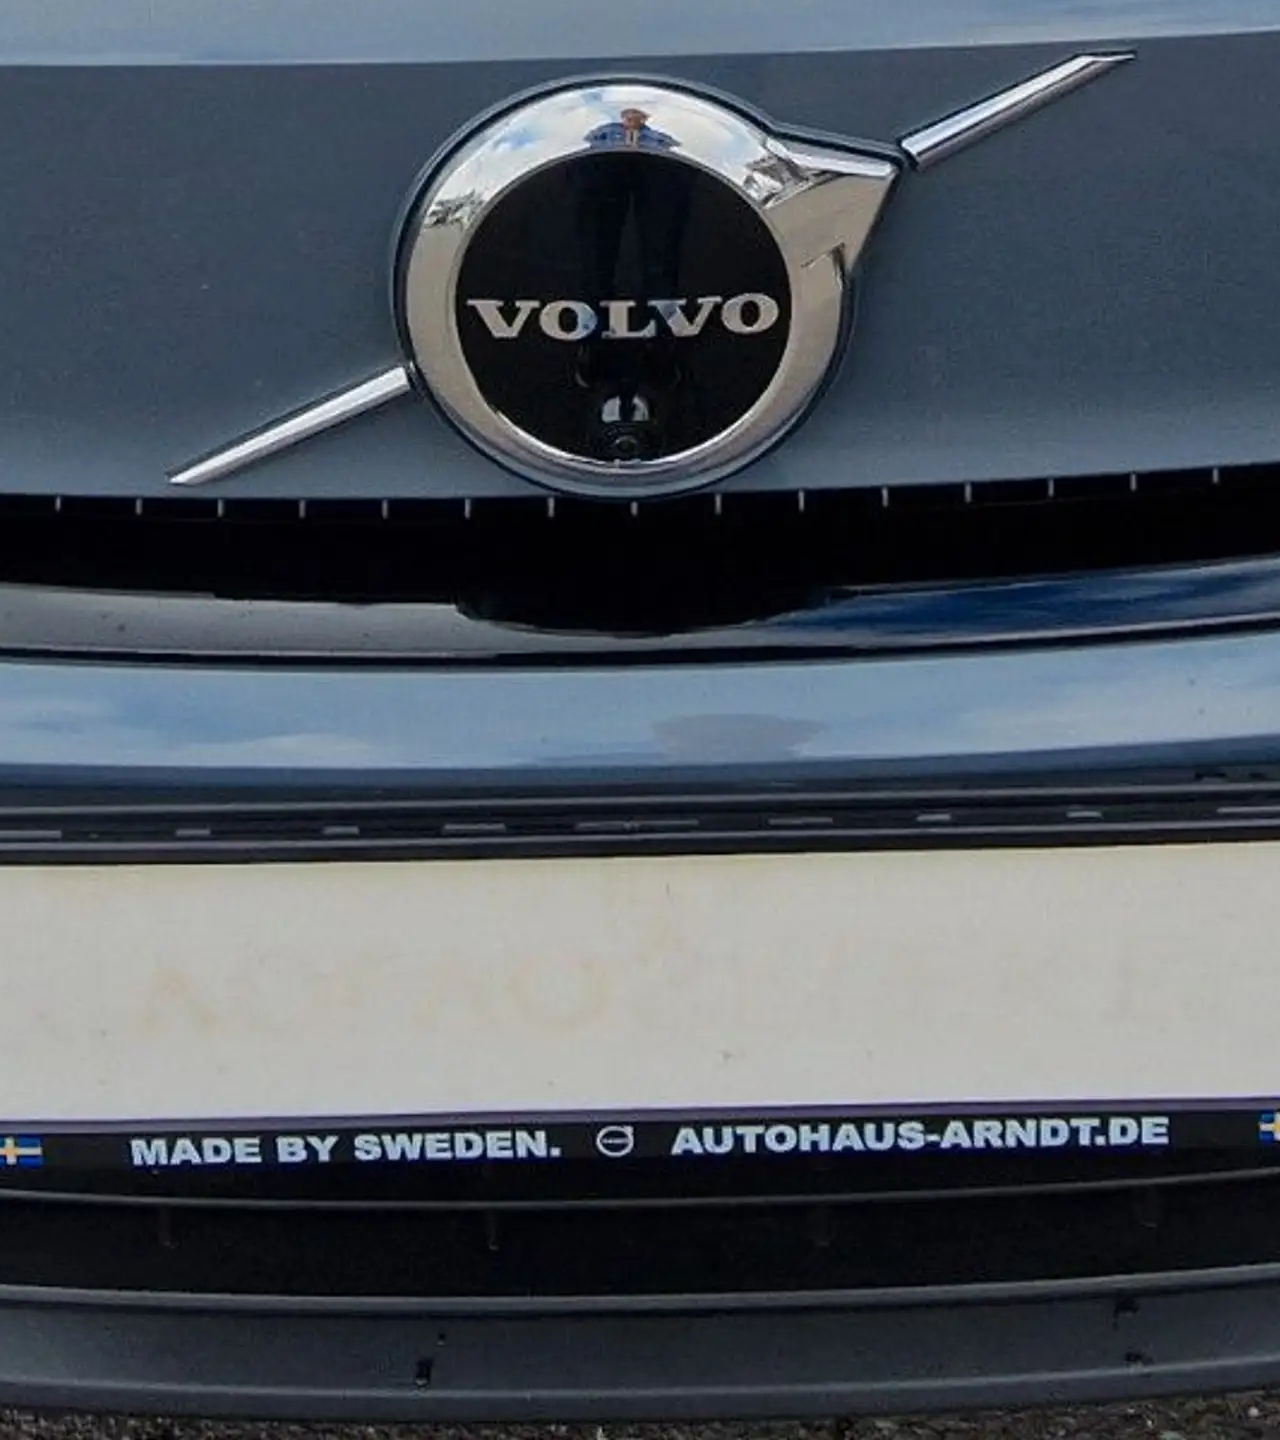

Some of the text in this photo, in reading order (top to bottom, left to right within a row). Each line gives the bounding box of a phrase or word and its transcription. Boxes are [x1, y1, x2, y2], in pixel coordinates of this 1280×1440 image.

[466, 292, 780, 341] VOLVO
[130, 1129, 561, 1166] MADE BY SWEDEN.
[671, 1116, 1170, 1156] AUTOHAUS-ARNDT.DE
